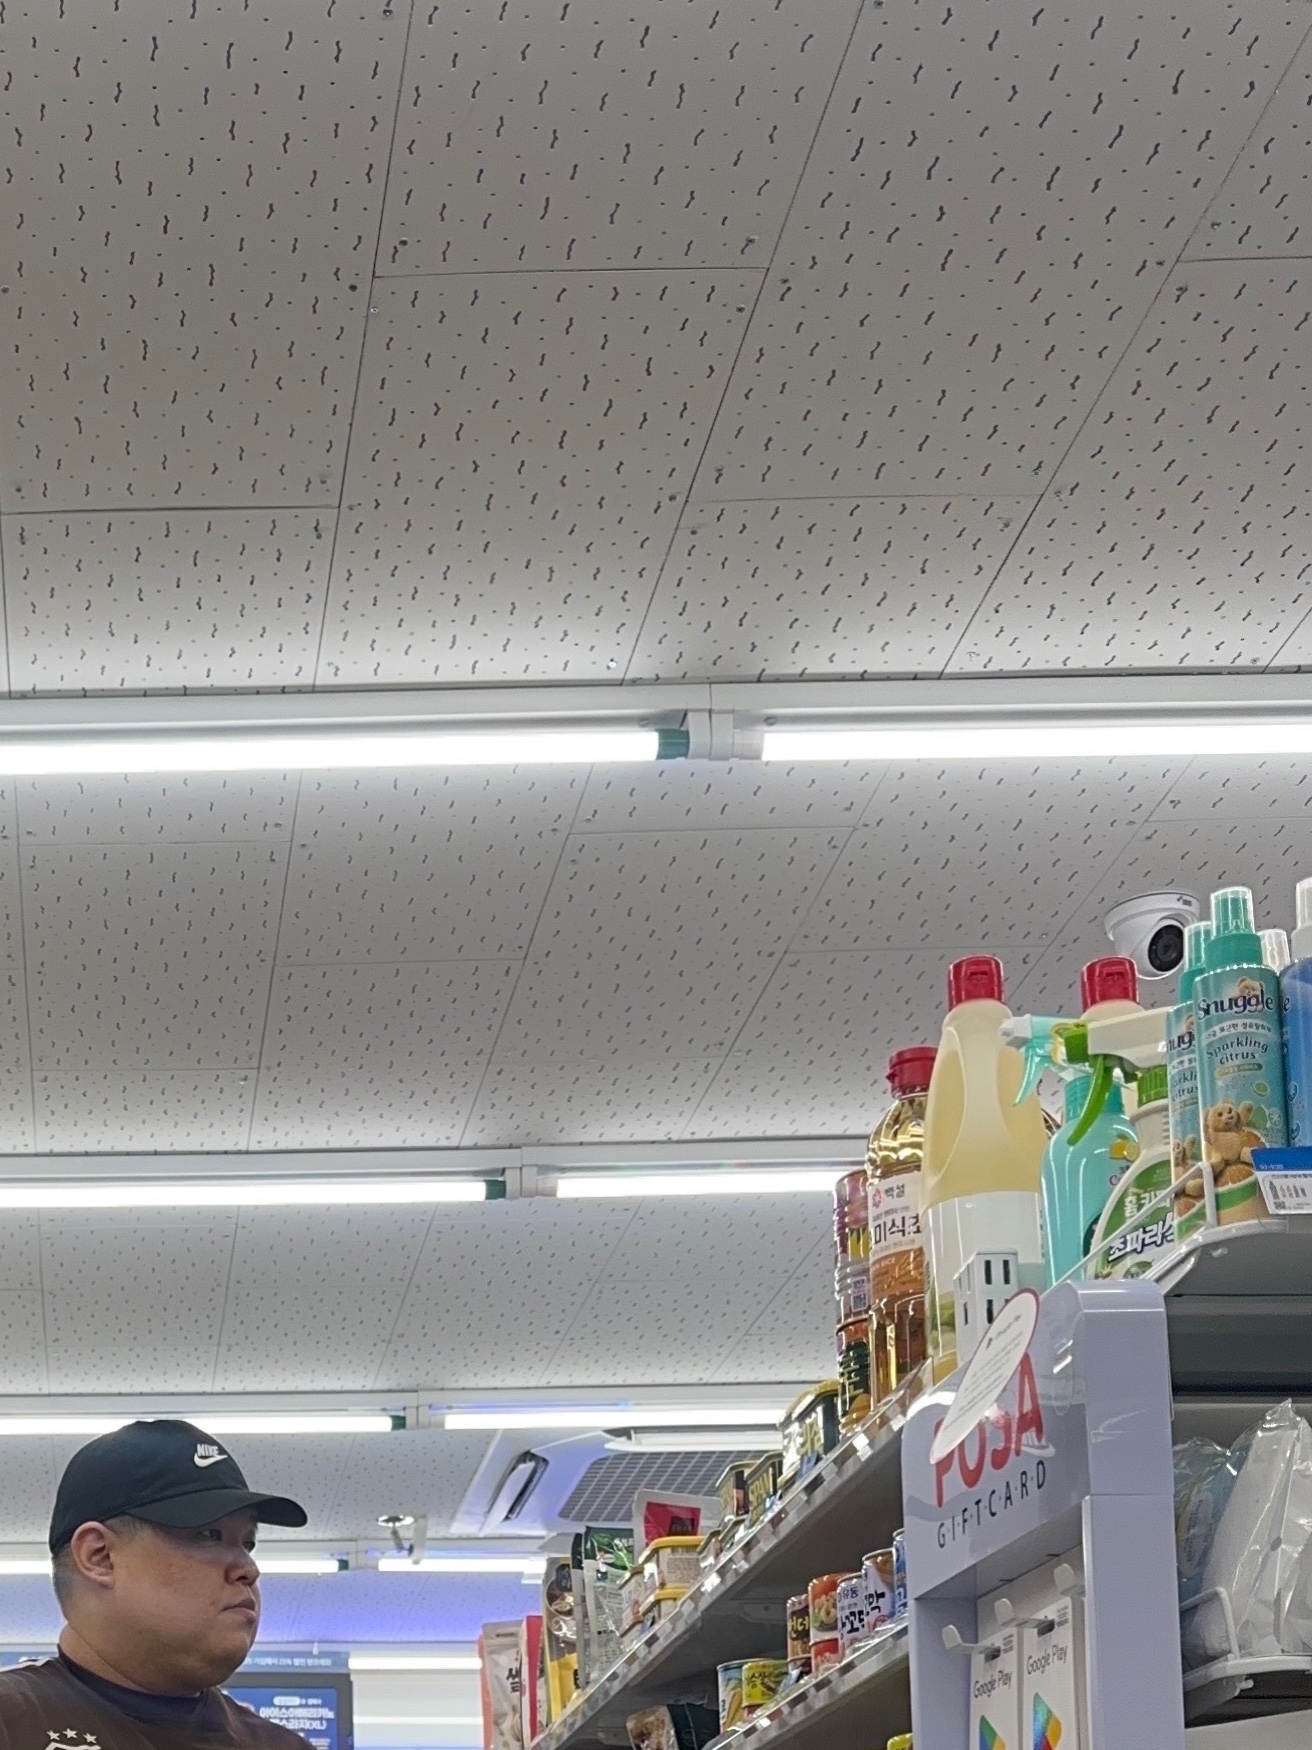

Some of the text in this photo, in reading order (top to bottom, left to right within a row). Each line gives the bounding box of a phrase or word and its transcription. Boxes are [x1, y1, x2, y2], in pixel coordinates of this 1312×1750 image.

[1197, 983, 1275, 1020] Snuggle
[1206, 1036, 1269, 1060] Sparkling
[1219, 1052, 1256, 1065] citrus
[197, 1443, 220, 1457] NIKE
[1026, 1644, 1069, 1676] Google Play
[973, 1671, 1013, 1700] Google Play
